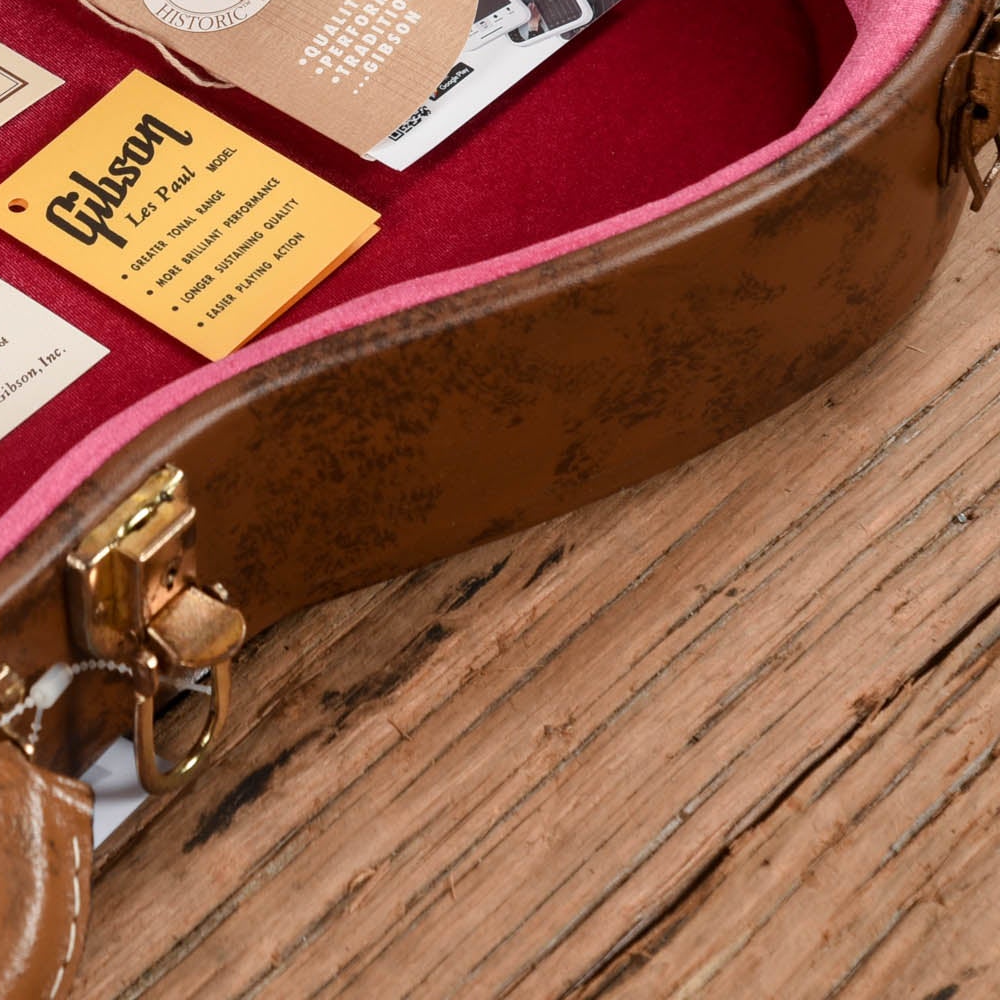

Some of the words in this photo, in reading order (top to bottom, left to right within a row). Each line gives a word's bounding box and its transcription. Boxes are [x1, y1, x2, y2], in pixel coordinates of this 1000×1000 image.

[156, 3, 248, 31] HISTORIC
[45, 113, 194, 250] Gibson
[123, 201, 158, 228] Les
[153, 164, 196, 204] Paul
[204, 146, 238, 174] MODEL
[129, 240, 169, 272] GREATER
[166, 215, 198, 240] TONAL
[194, 189, 226, 216] RANGE
[154, 264, 183, 288] MORE
[180, 227, 224, 265] BRILLIANT
[222, 176, 281, 229] PERFORMANCE
[179, 273, 216, 304] LONGER
[213, 230, 265, 274] SUSTAINING
[262, 197, 299, 231] QUALITY
[205, 293, 238, 320] EASIER
[234, 260, 273, 294] PLAYING
[272, 231, 306, 262] ACTION
[37, 347, 67, 368] Inc.
